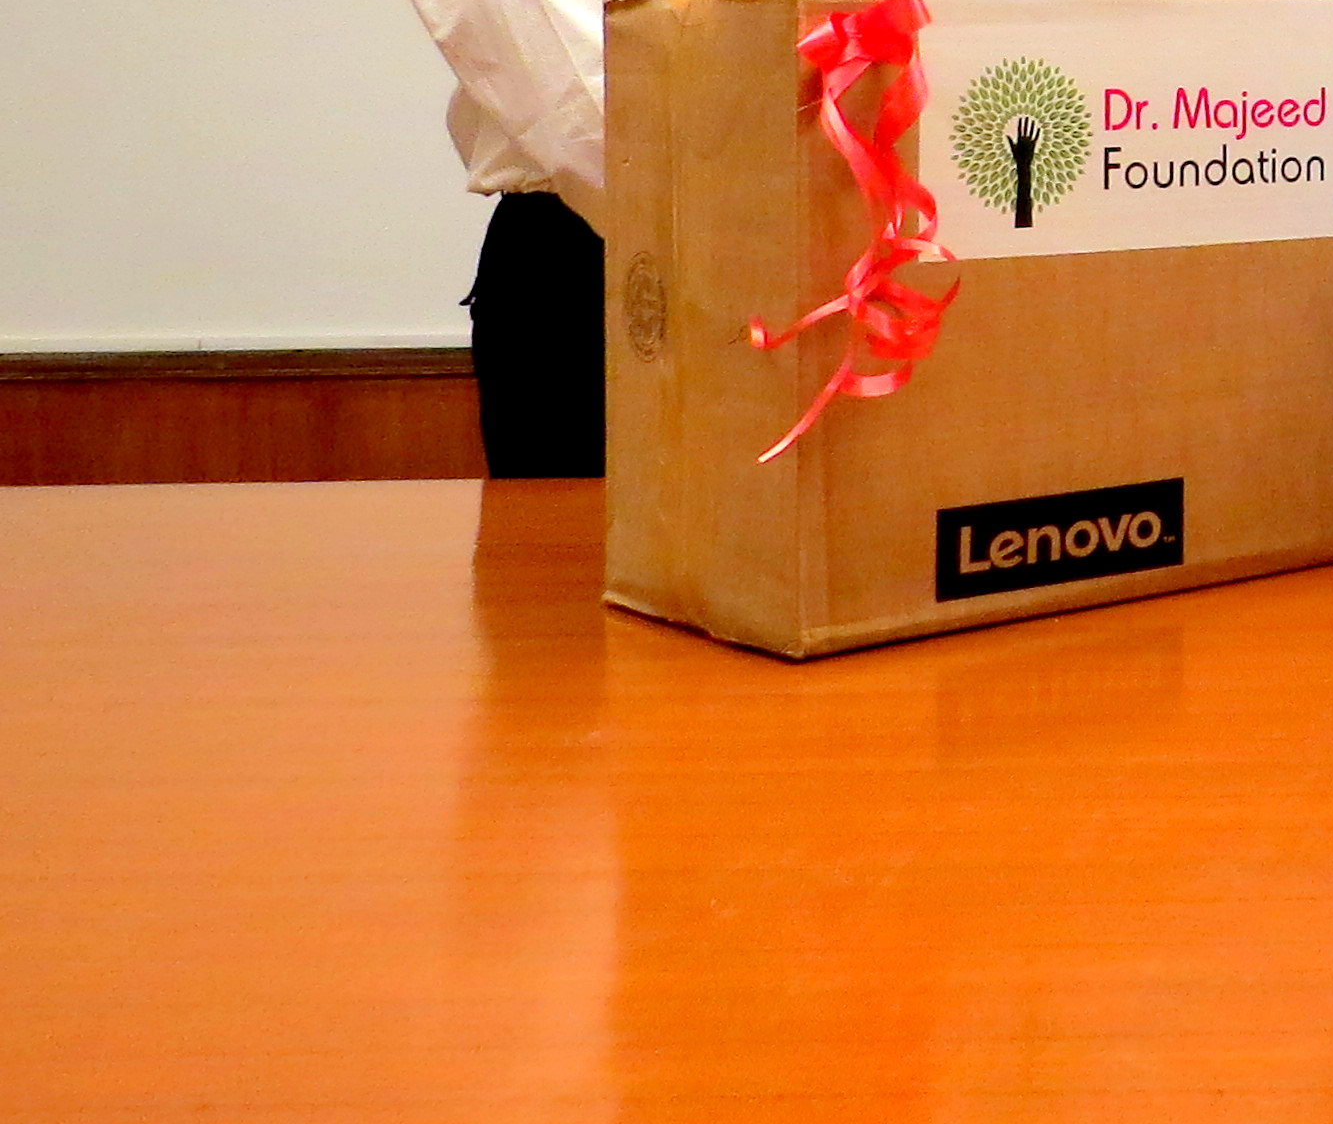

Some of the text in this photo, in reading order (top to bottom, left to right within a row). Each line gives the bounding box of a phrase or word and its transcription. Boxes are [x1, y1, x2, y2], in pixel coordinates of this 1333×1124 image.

[1103, 86, 1327, 141] Dr. Majeed
[1103, 144, 1326, 191] Foundation
[959, 510, 1162, 575] Lenovo
